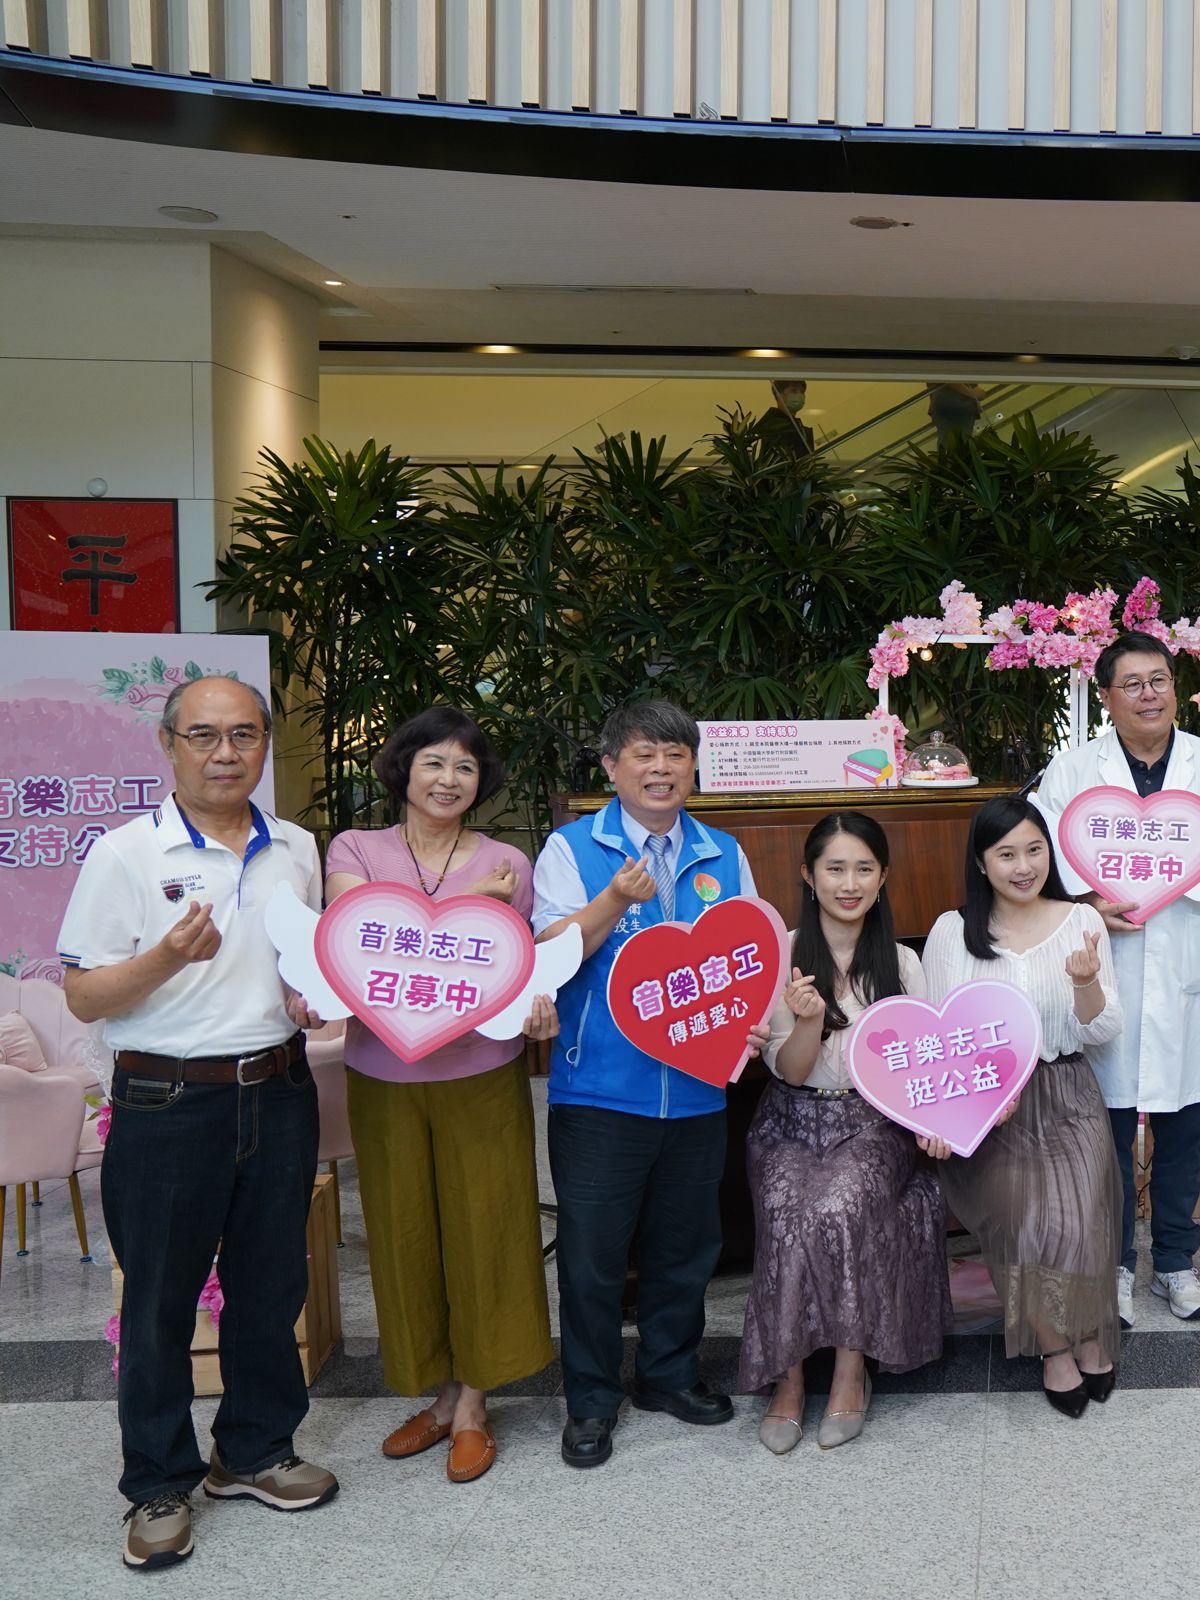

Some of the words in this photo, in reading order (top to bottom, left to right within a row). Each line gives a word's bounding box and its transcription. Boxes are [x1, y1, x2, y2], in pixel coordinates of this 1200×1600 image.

[62, 534, 138, 615] 平
[707, 726, 750, 738] 公益演奏
[756, 725, 798, 737] 支持弱勢
[1089, 817, 1190, 842] 音樂志工
[1099, 854, 1183, 882] 召募中
[359, 921, 491, 962] 音樂志工
[366, 969, 478, 1012] 召募中
[634, 945, 762, 1019] 音樂志工
[668, 997, 749, 1046] 傳遞愛心
[881, 1020, 1010, 1072] 音樂志工
[905, 1060, 1002, 1108] 挺公益
